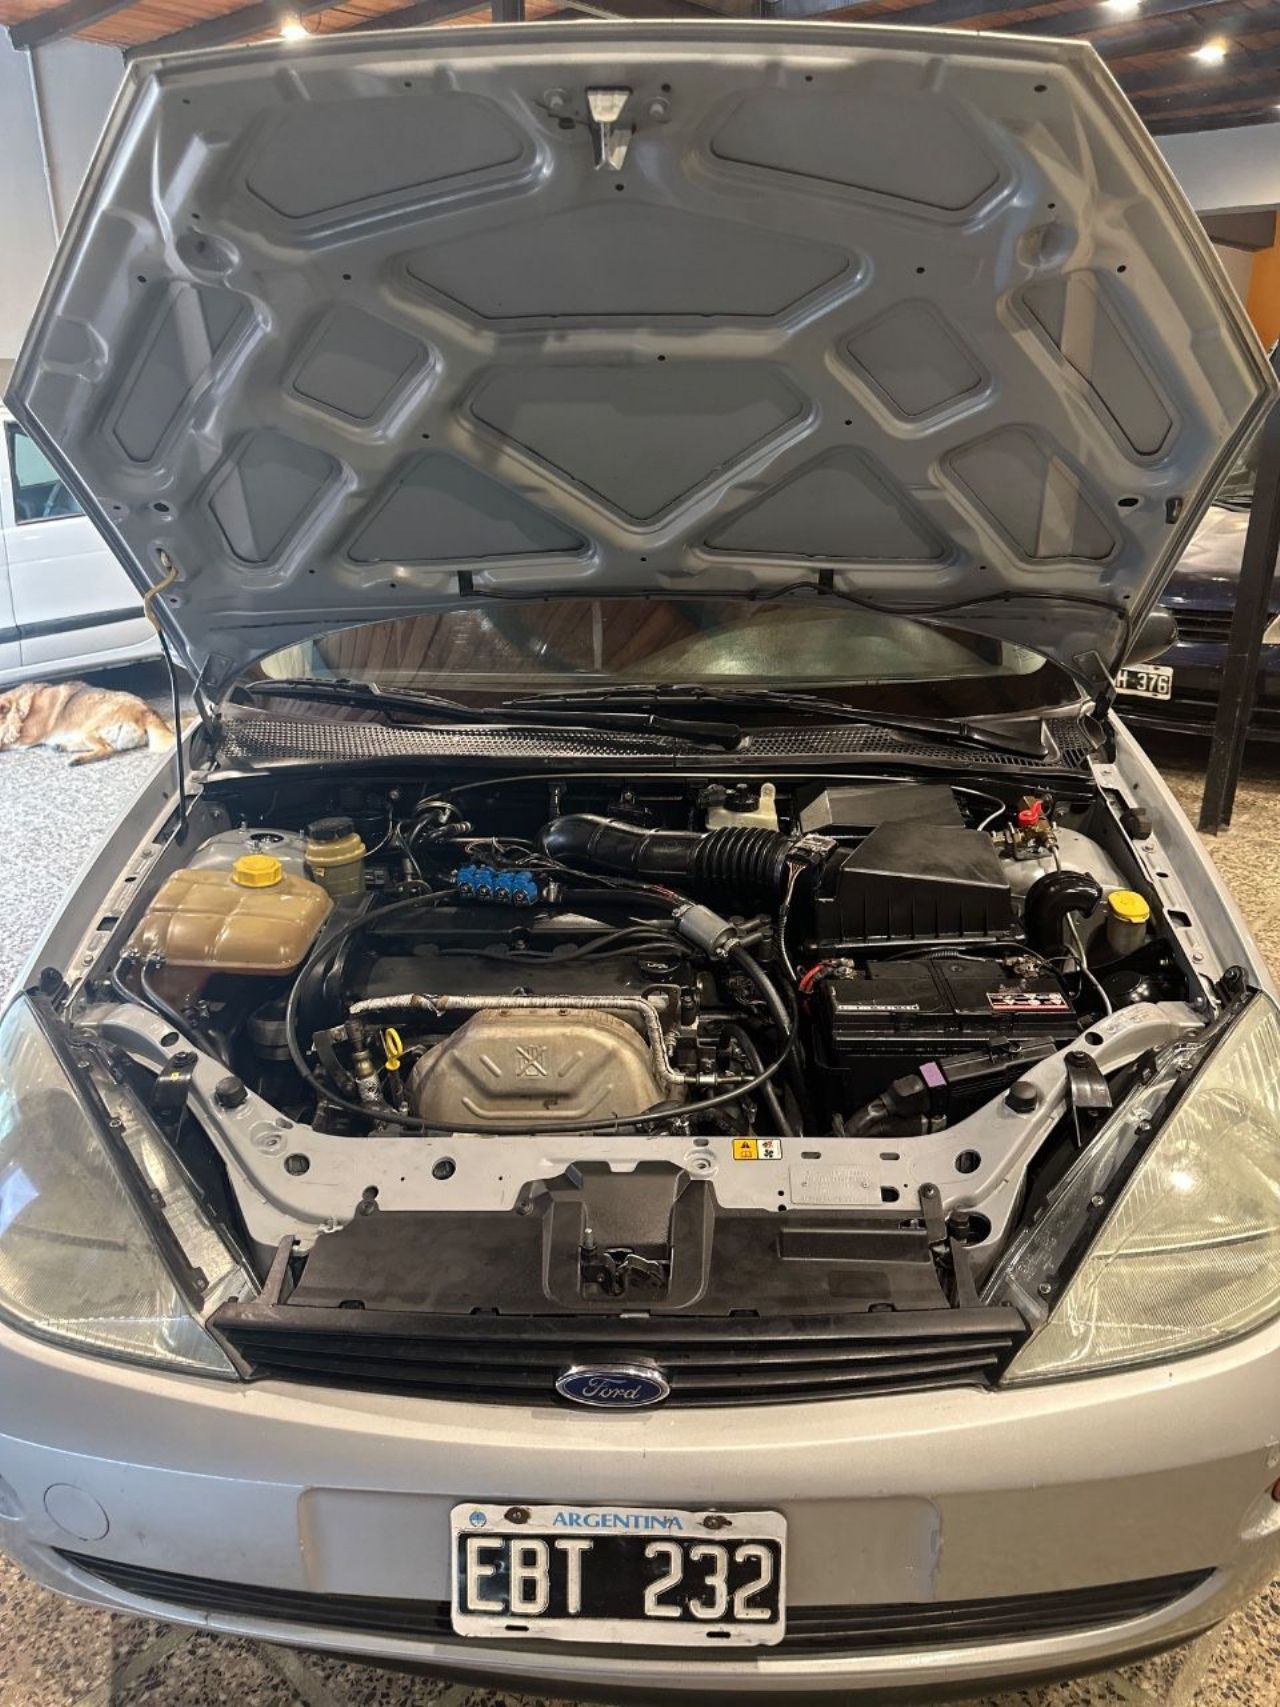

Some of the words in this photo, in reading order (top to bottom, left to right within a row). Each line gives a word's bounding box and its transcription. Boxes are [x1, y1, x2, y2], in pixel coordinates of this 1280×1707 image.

[1116, 670, 1128, 688] H
[1137, 673, 1169, 693] 376
[582, 1376, 642, 1400] Ford
[552, 1511, 684, 1530] ARGENTINA
[466, 1537, 594, 1615] EBT
[644, 1540, 774, 1620] 232
